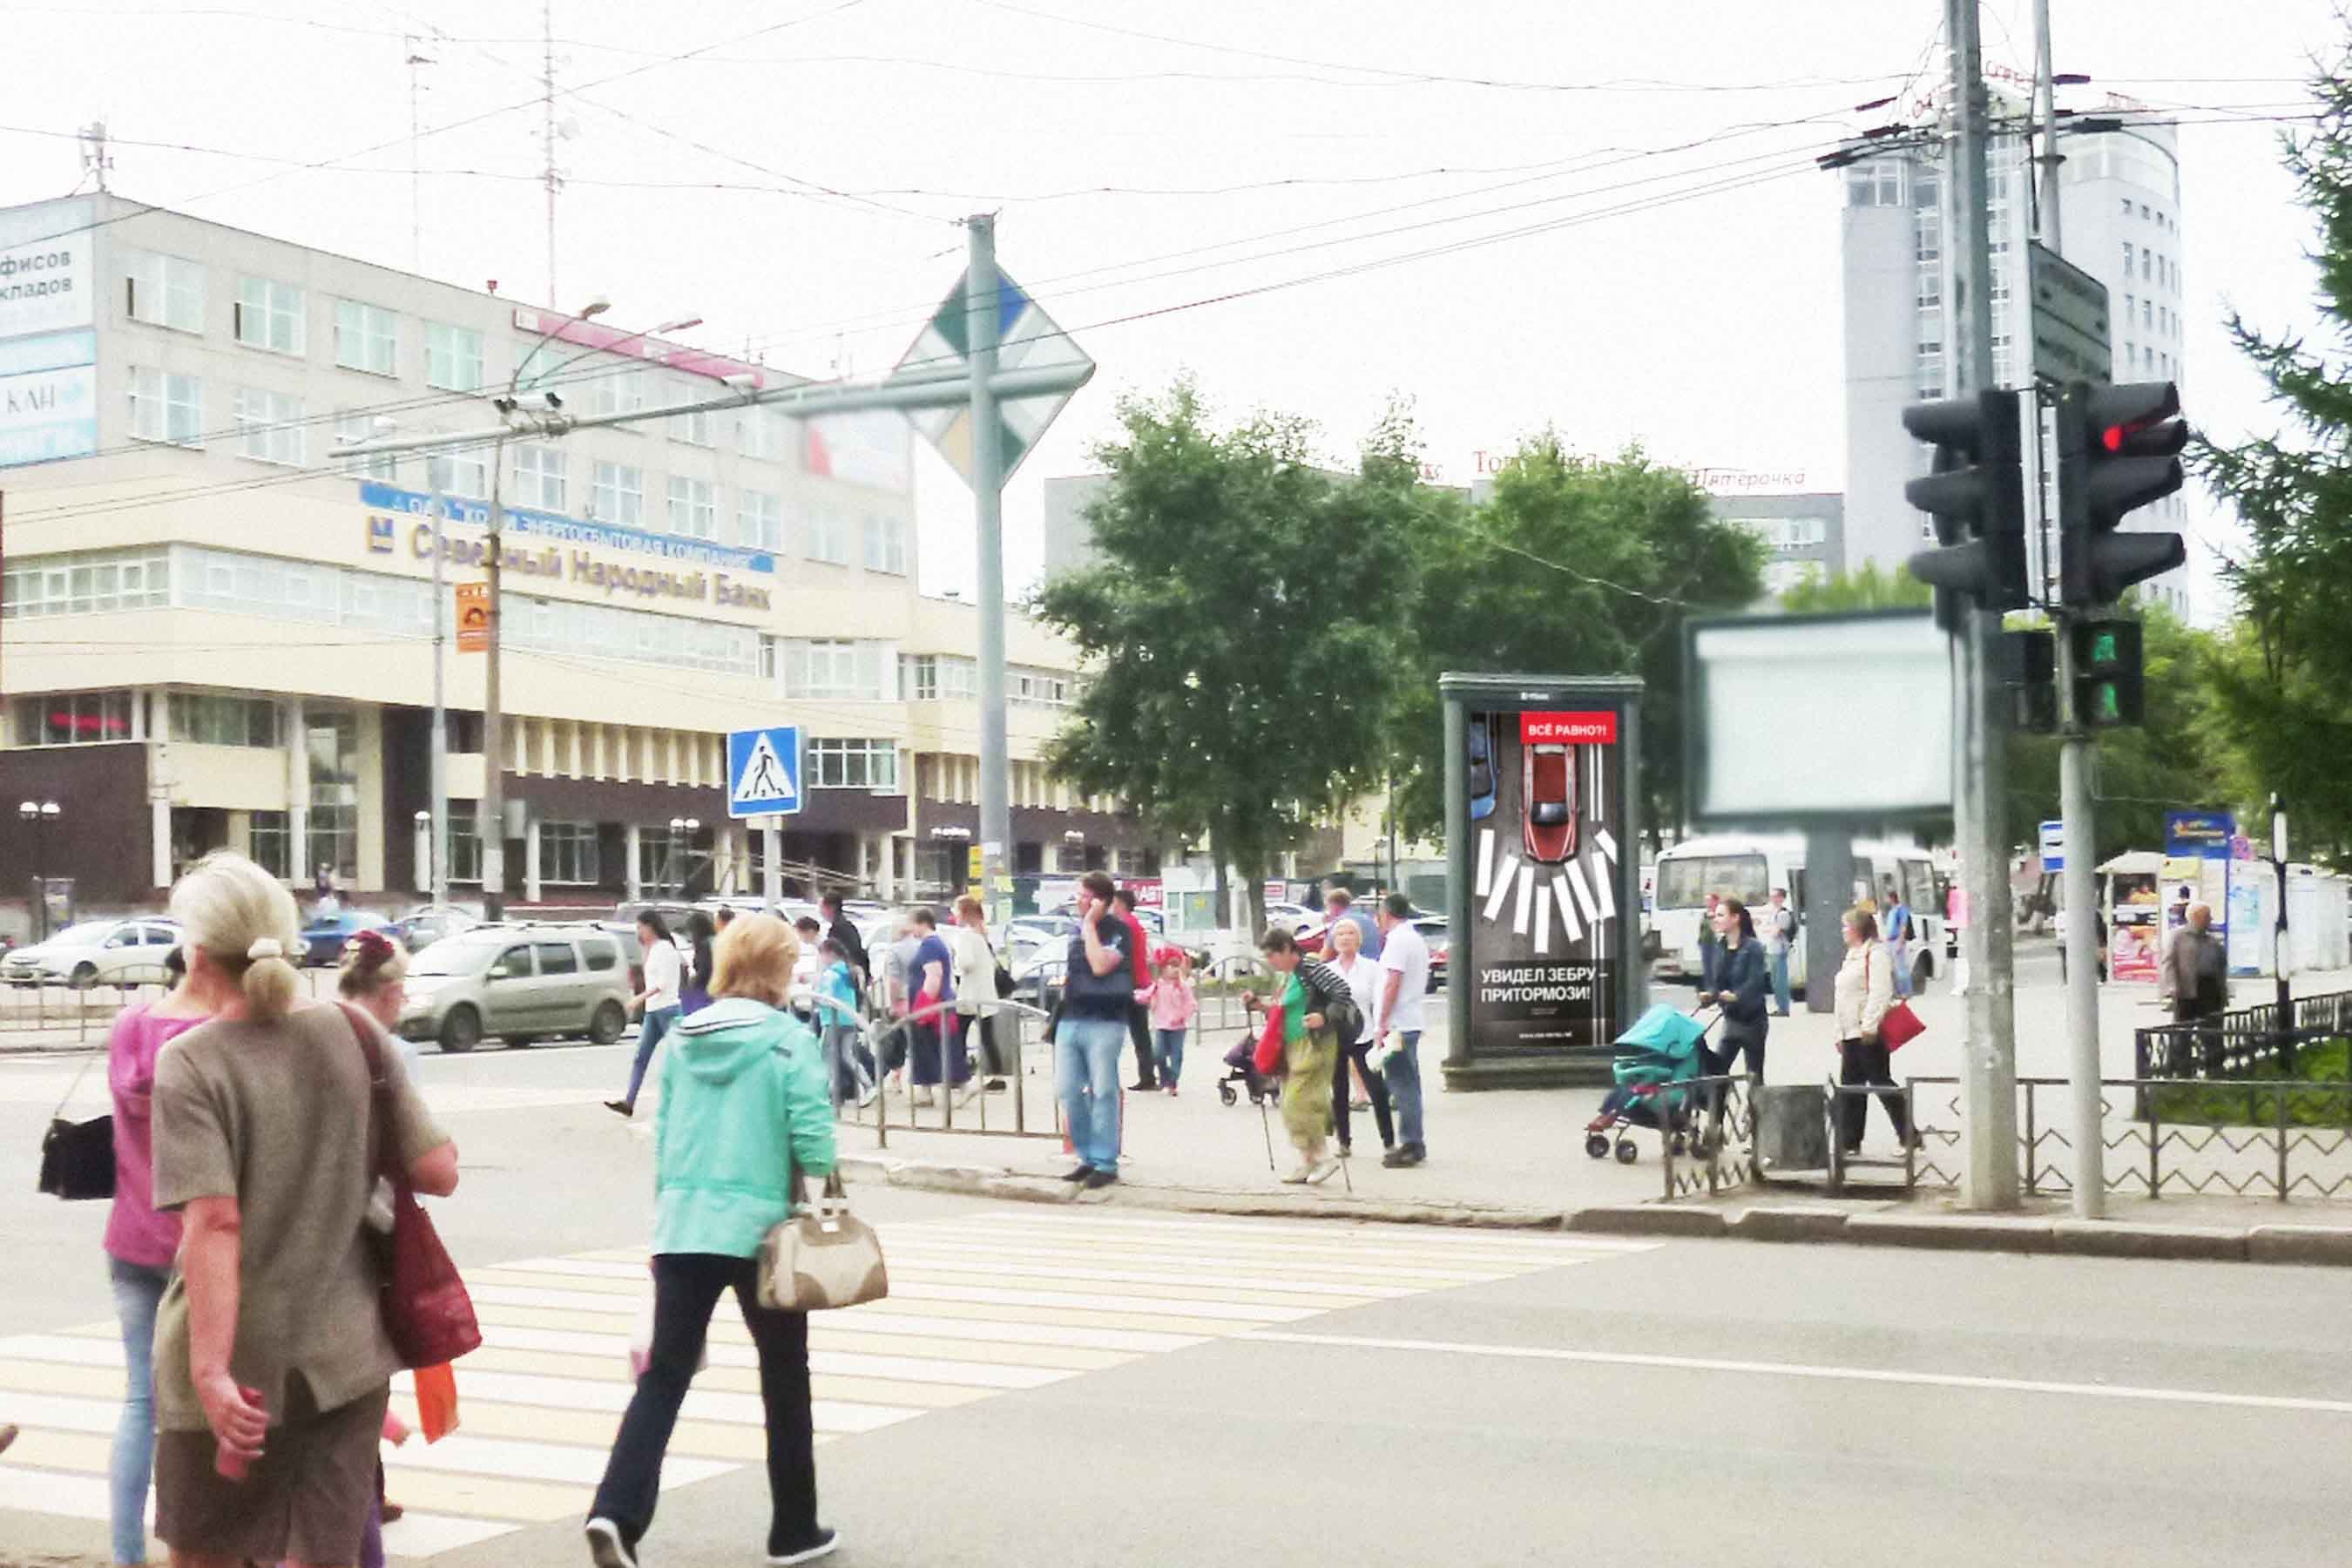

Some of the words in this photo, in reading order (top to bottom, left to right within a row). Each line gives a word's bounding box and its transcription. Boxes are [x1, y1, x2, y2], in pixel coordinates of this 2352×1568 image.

[411, 523, 562, 578] Севеный
[571, 547, 706, 599] Народный
[712, 571, 771, 612] Банк
[1528, 722, 1552, 737] ВСЁ
[1555, 724, 1607, 738] РАВНО?!
[1481, 968, 1545, 984] УВИДЕЛ
[1548, 966, 1597, 983] ЗЕБРУ
[1481, 986, 1592, 1003] ПРИТОРМОЗИ!
